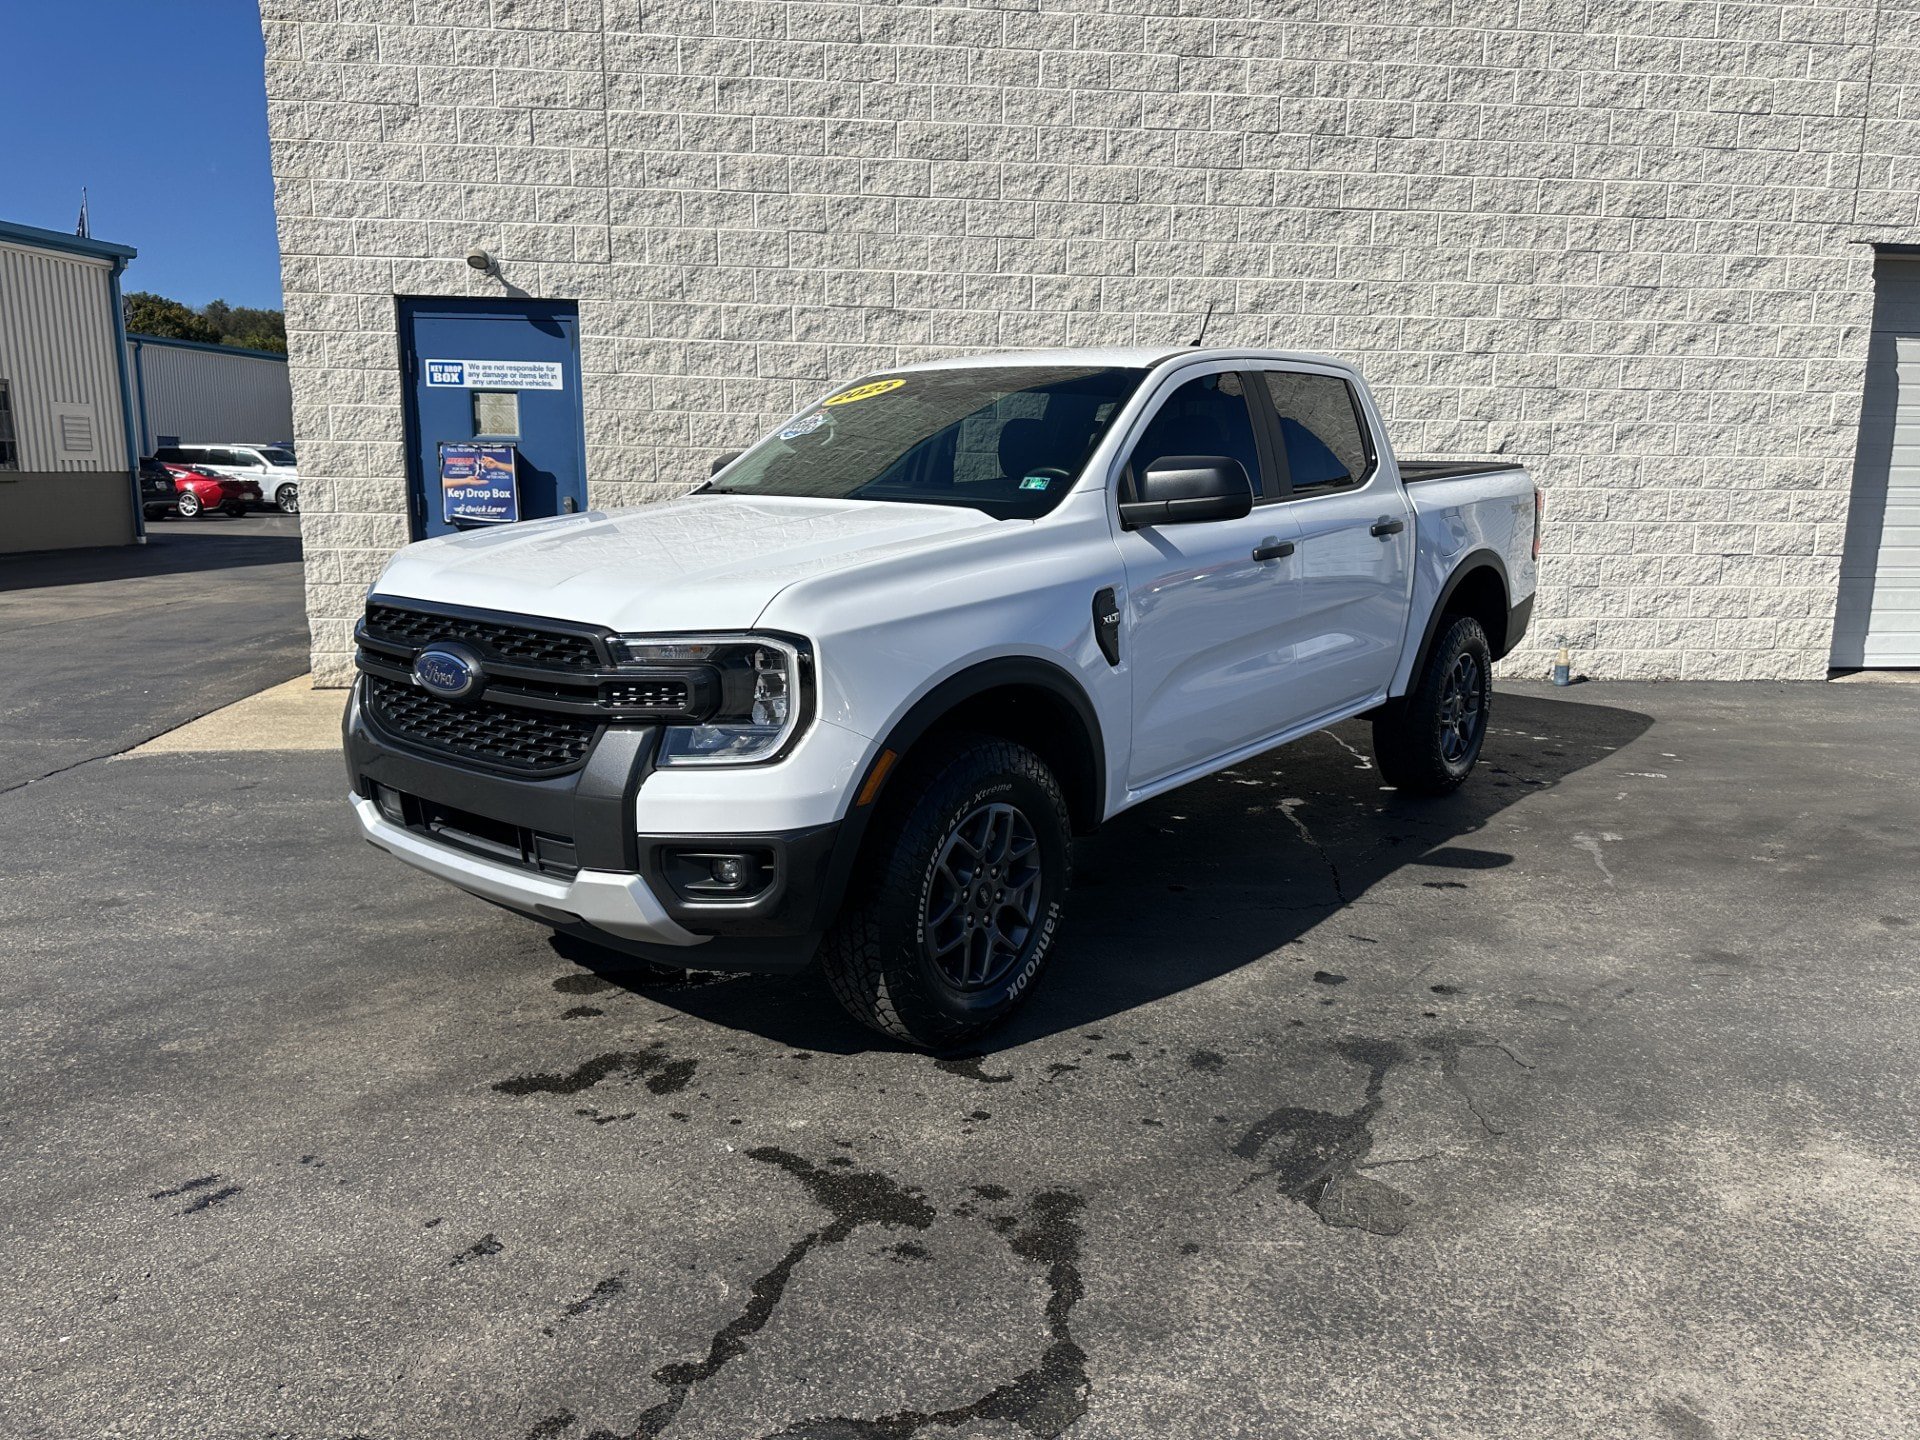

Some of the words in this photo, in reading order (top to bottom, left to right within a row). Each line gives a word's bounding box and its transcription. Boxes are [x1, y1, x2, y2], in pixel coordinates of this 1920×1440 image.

[430, 365, 443, 373] KEY
[444, 365, 463, 373] DROP
[481, 371, 508, 379] damage
[506, 364, 544, 373] responsible
[433, 373, 460, 383] BOX
[831, 381, 899, 402] 2025
[447, 487, 465, 500] Key
[466, 488, 491, 500] Drop
[492, 488, 511, 499] Box
[465, 505, 486, 513] Quick
[487, 505, 507, 513] Lane
[1102, 611, 1120, 626] XLT
[424, 660, 456, 687] Ford
[947, 801, 970, 832] AT2
[973, 783, 1013, 805] Xtreme
[1006, 902, 1060, 1000] Hankook
